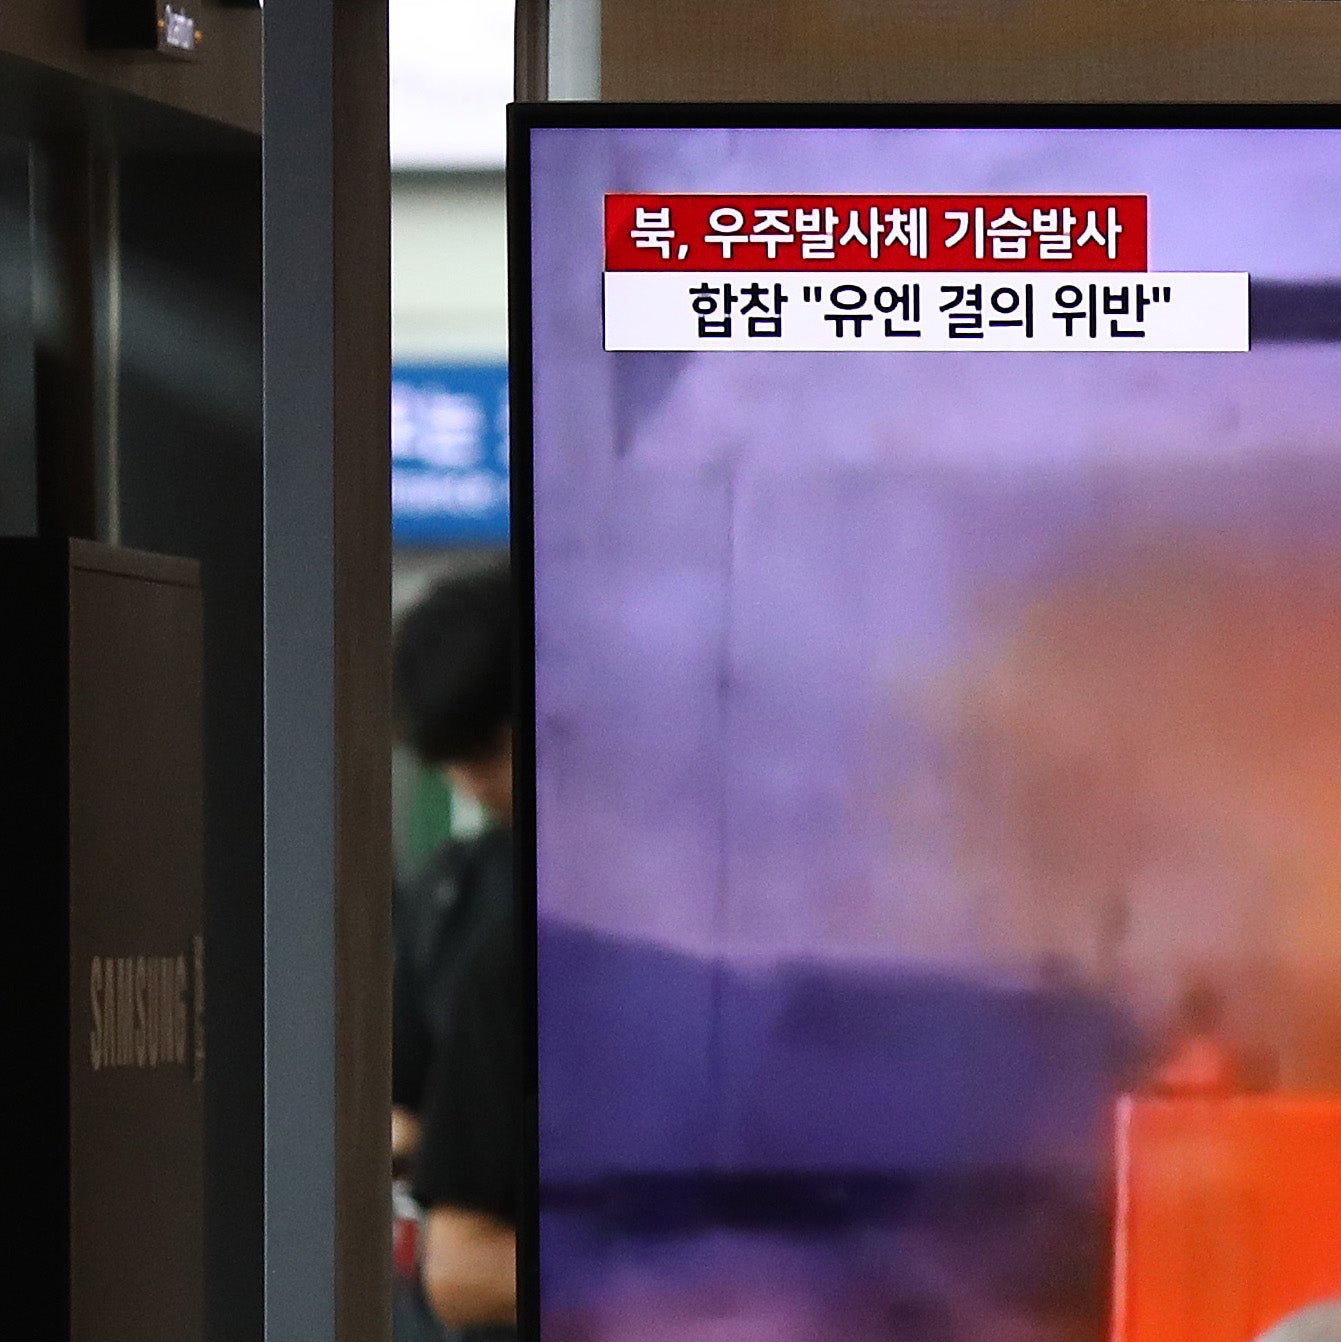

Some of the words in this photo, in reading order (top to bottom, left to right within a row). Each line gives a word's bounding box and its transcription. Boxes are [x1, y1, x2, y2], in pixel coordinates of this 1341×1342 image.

[631, 206, 690, 261] 북,
[704, 206, 928, 260] 우주발사체
[944, 206, 1123, 260] 기습발사
[688, 282, 789, 338] 합참
[803, 283, 922, 338] "유엔
[939, 283, 1034, 339] 결의
[1052, 283, 1173, 339] 위반"
